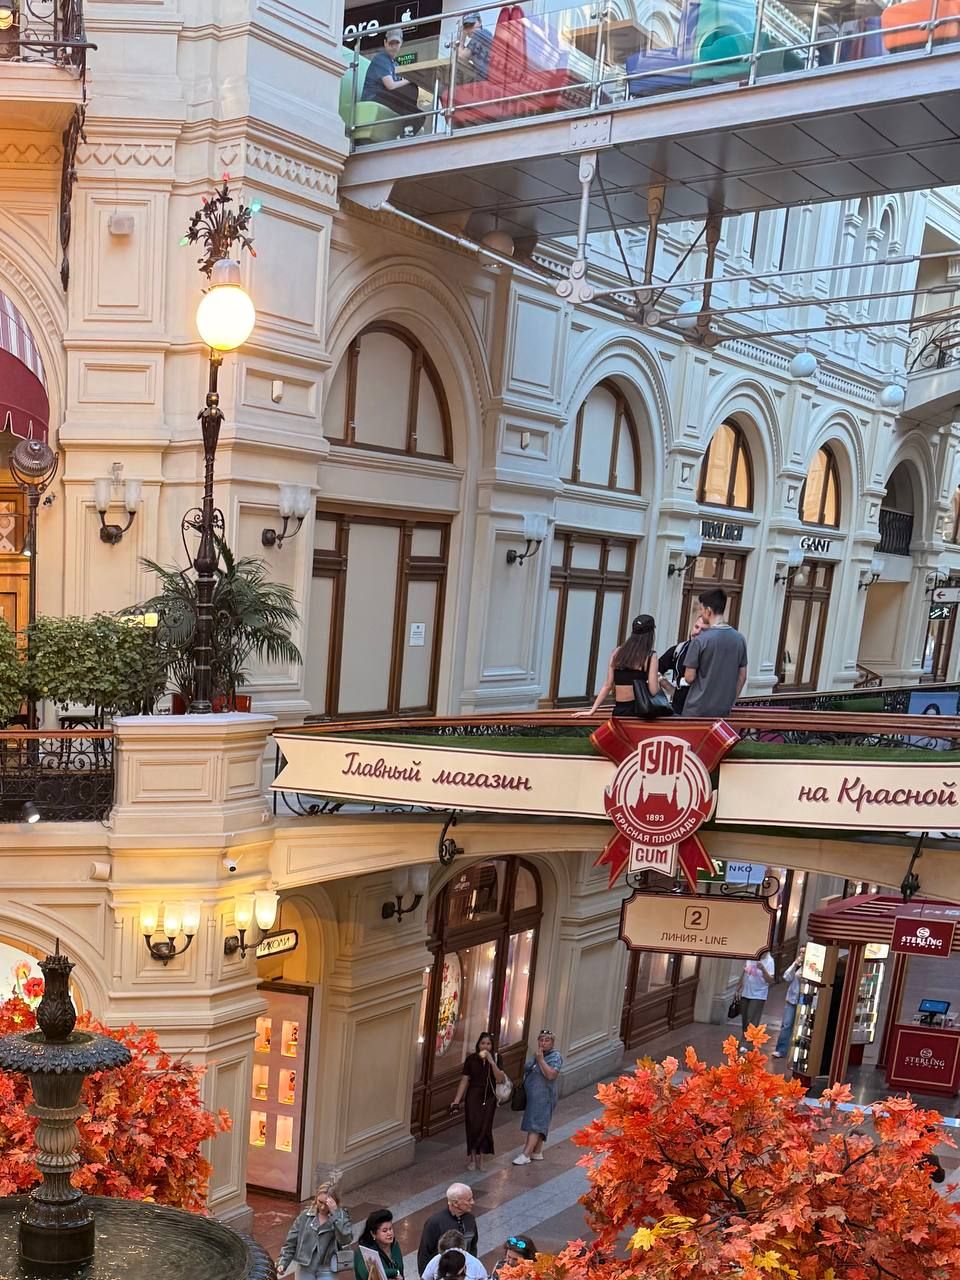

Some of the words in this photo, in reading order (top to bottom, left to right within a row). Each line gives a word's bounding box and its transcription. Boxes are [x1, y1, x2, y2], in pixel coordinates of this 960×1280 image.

[800, 536, 833, 553] GANT
[639, 741, 684, 776] ГУМ
[342, 751, 422, 782] Главный
[432, 767, 532, 791] магазин
[798, 785, 829, 802] на
[837, 777, 958, 812] Красной
[645, 813, 665, 822] 1893
[615, 812, 650, 843] КРАСНАЯ
[652, 817, 697, 844] ПЛОЩАДЬ
[635, 847, 668, 864] GUM
[690, 910, 702, 925] 2
[660, 932, 697, 943] ЛИНИЯ
[705, 935, 729, 946] LINE
[900, 936, 943, 947] STERLING
